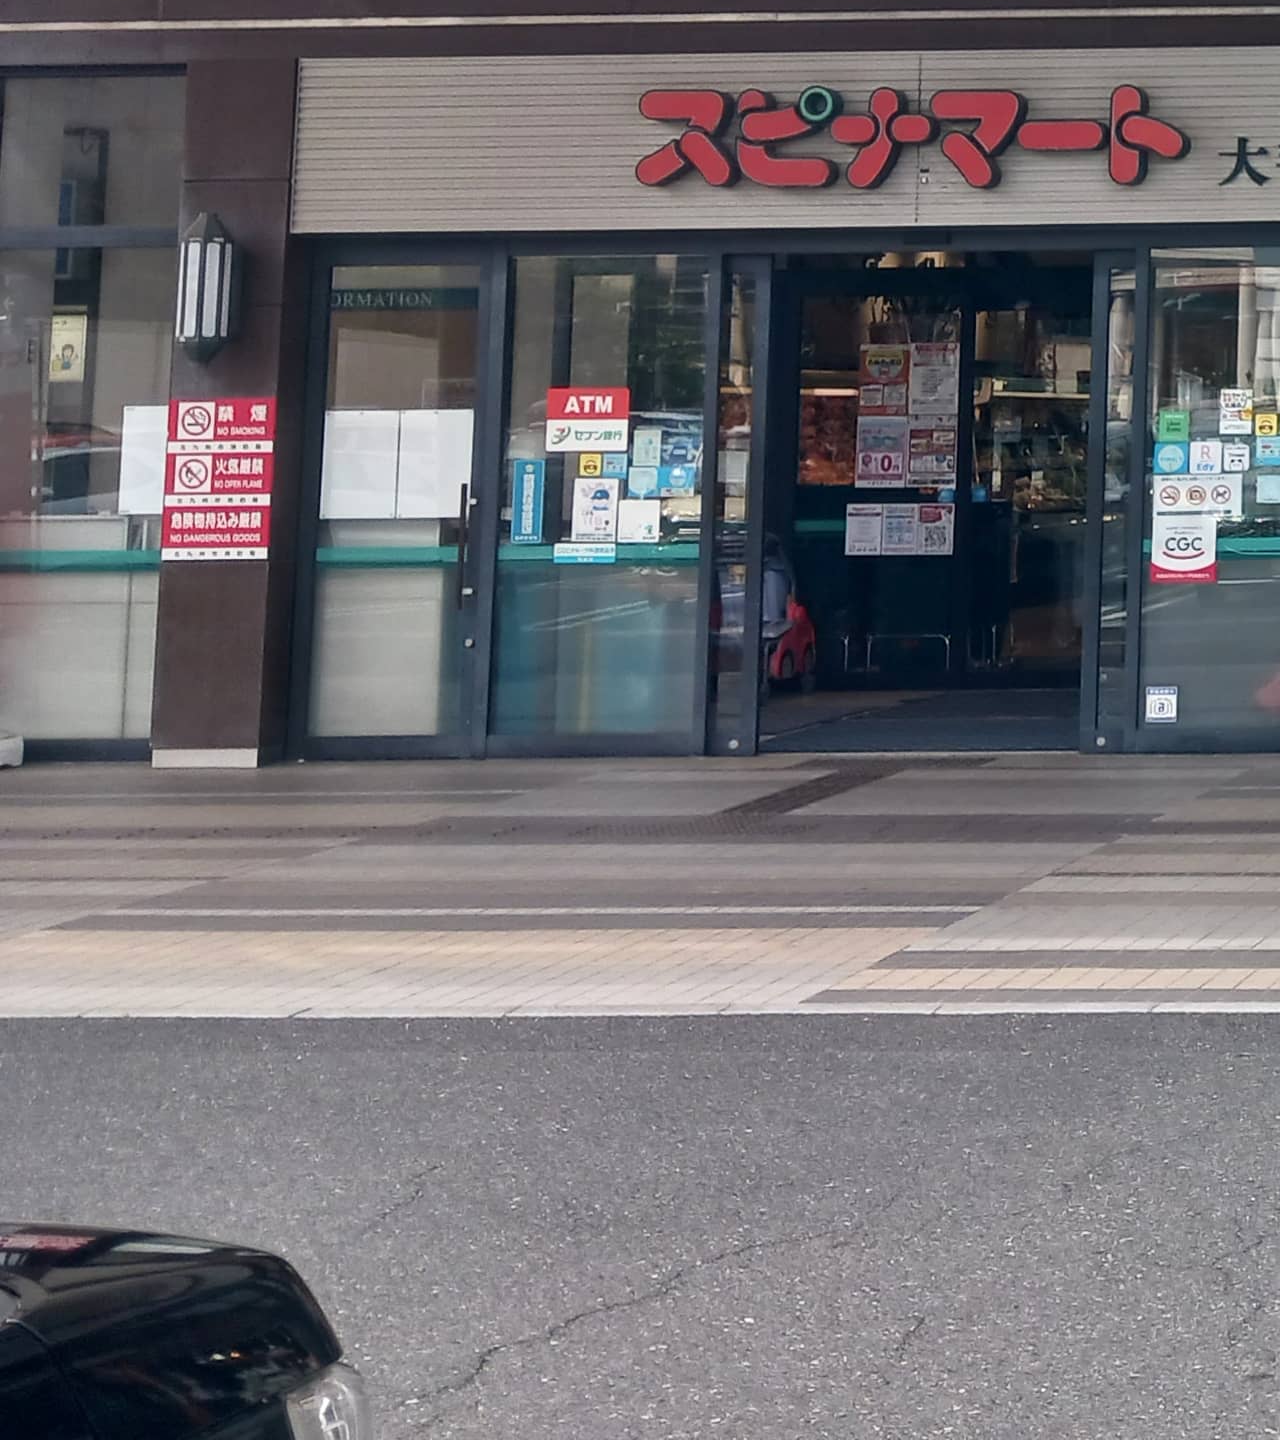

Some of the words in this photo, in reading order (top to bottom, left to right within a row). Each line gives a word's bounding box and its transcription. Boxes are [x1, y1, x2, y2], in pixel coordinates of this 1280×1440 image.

[634, 84, 1191, 188] スピナマート
[564, 395, 614, 413] ATM
[574, 429, 622, 442] セブン銀行
[1165, 537, 1203, 551] CGC
